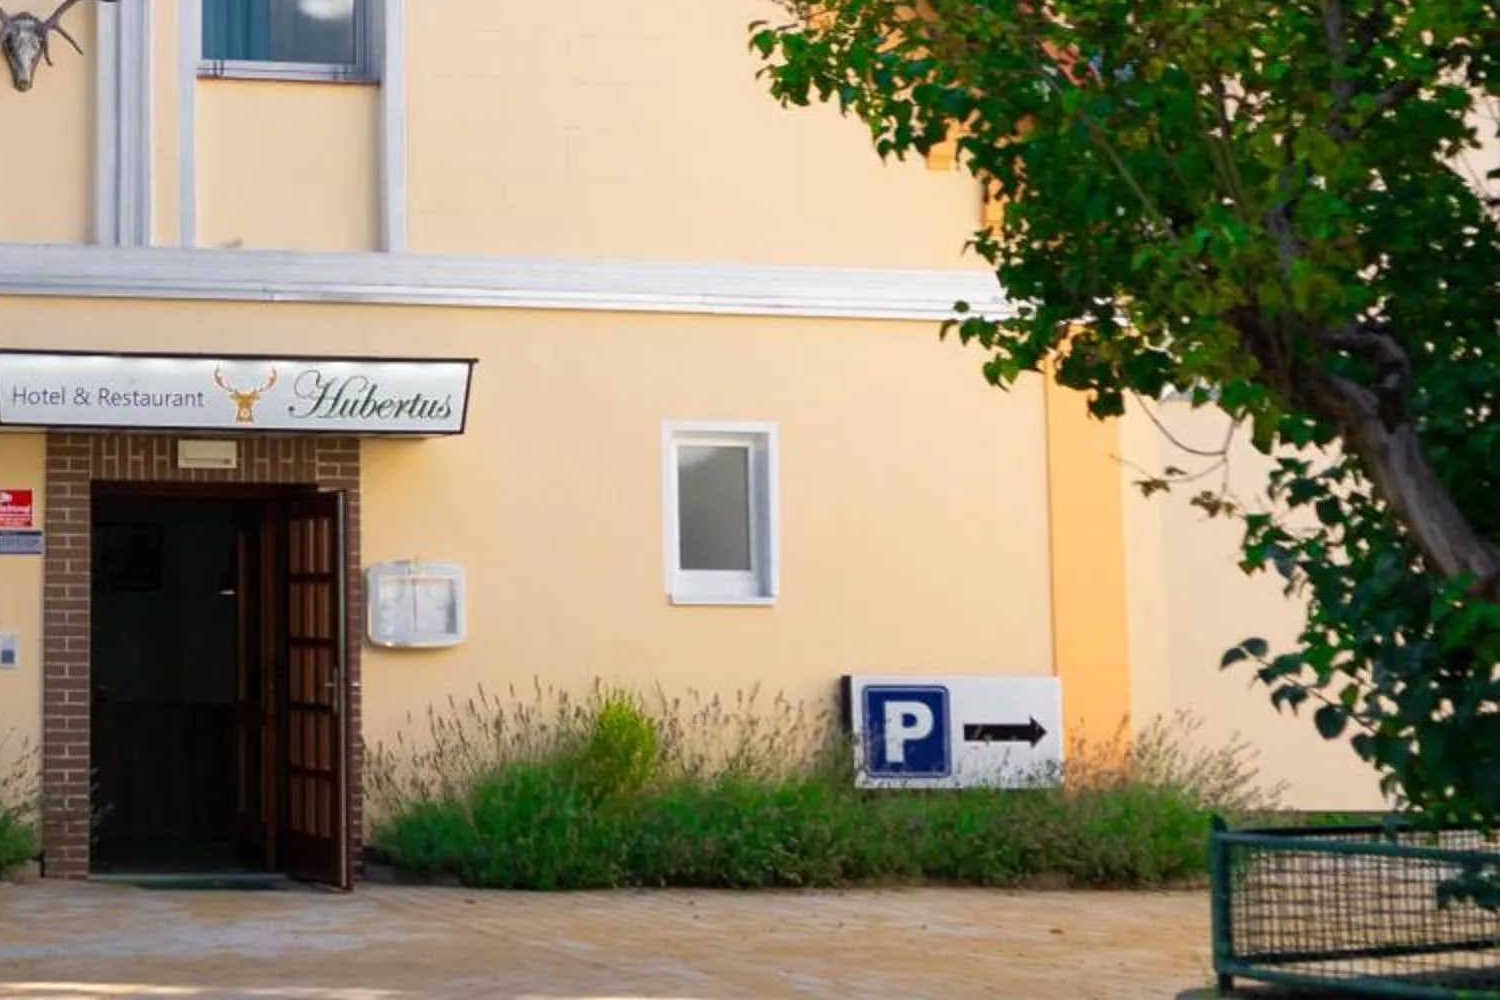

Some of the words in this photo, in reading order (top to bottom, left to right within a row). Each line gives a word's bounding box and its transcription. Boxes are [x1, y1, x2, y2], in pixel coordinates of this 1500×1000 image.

[12, 385, 66, 406] Hotel
[73, 387, 91, 407] &
[99, 387, 206, 409] Restaurant
[288, 369, 453, 419] Hubertus
[884, 700, 934, 763] P
